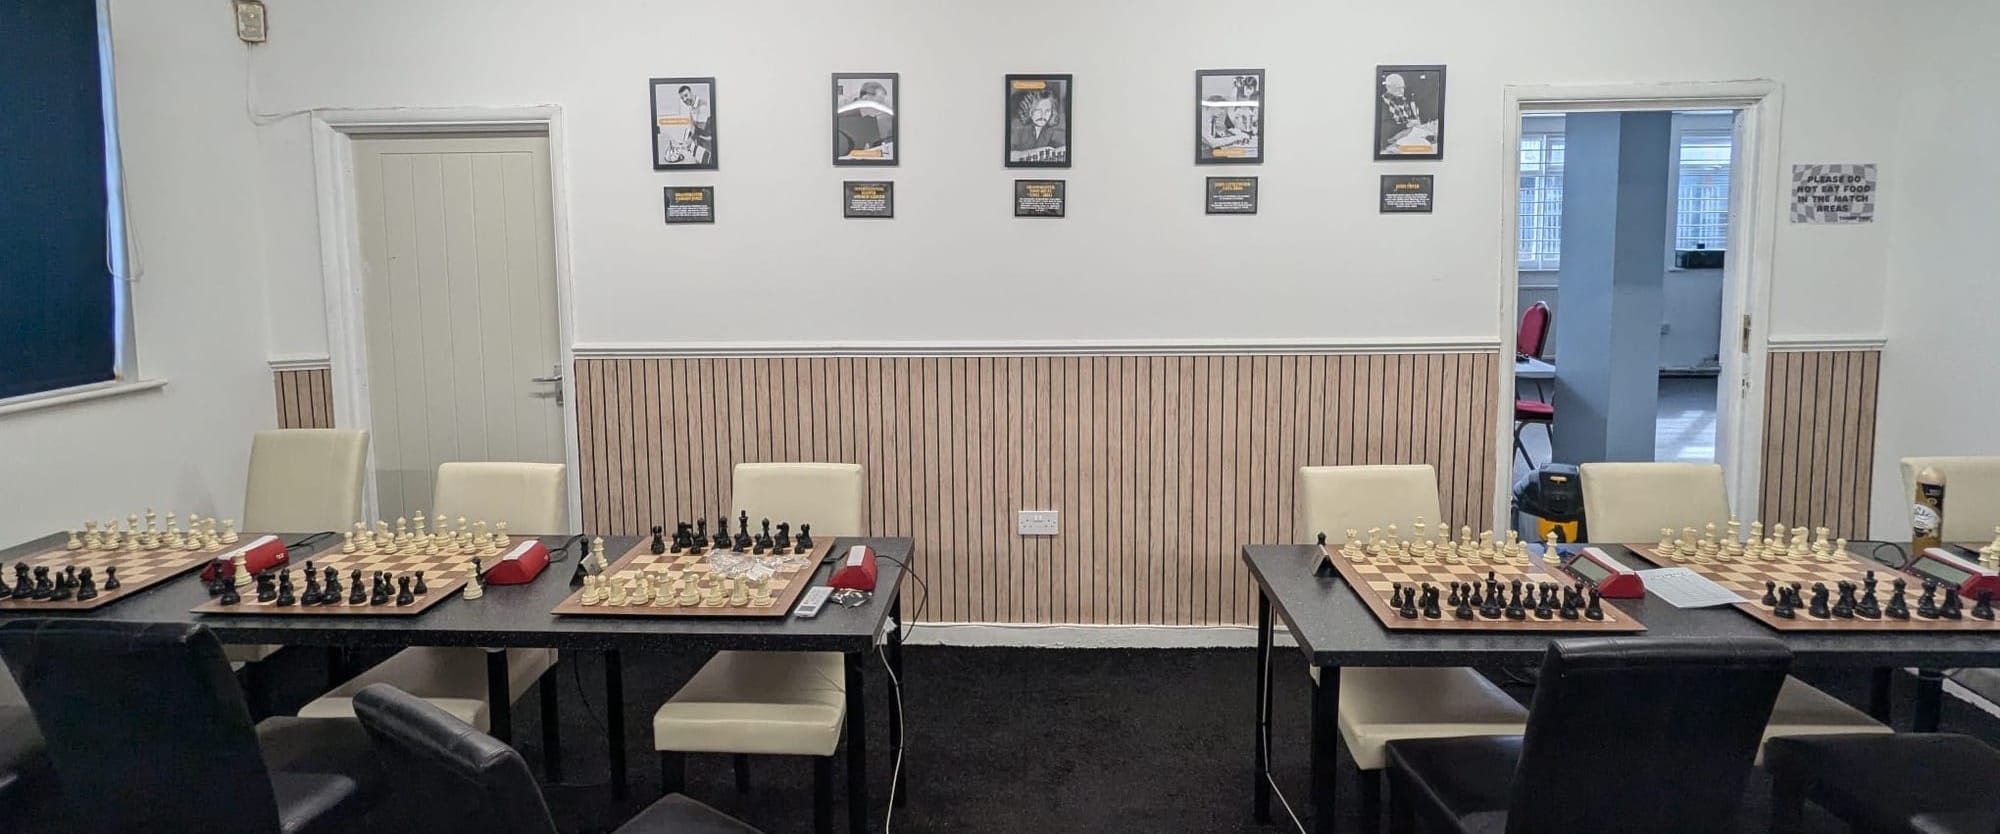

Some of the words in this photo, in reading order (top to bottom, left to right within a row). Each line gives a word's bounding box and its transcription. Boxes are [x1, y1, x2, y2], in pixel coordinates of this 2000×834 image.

[1807, 175, 1844, 183] PLEASE
[1847, 175, 1861, 183] DO
[1797, 185, 1818, 193] NOT
[1821, 185, 1840, 193] EAT
[1843, 185, 1871, 193] FOOD
[1797, 195, 1808, 203] IN
[1812, 195, 1830, 203] THE
[1834, 195, 1868, 203] MATCH
[1816, 205, 1849, 213] AREAS
